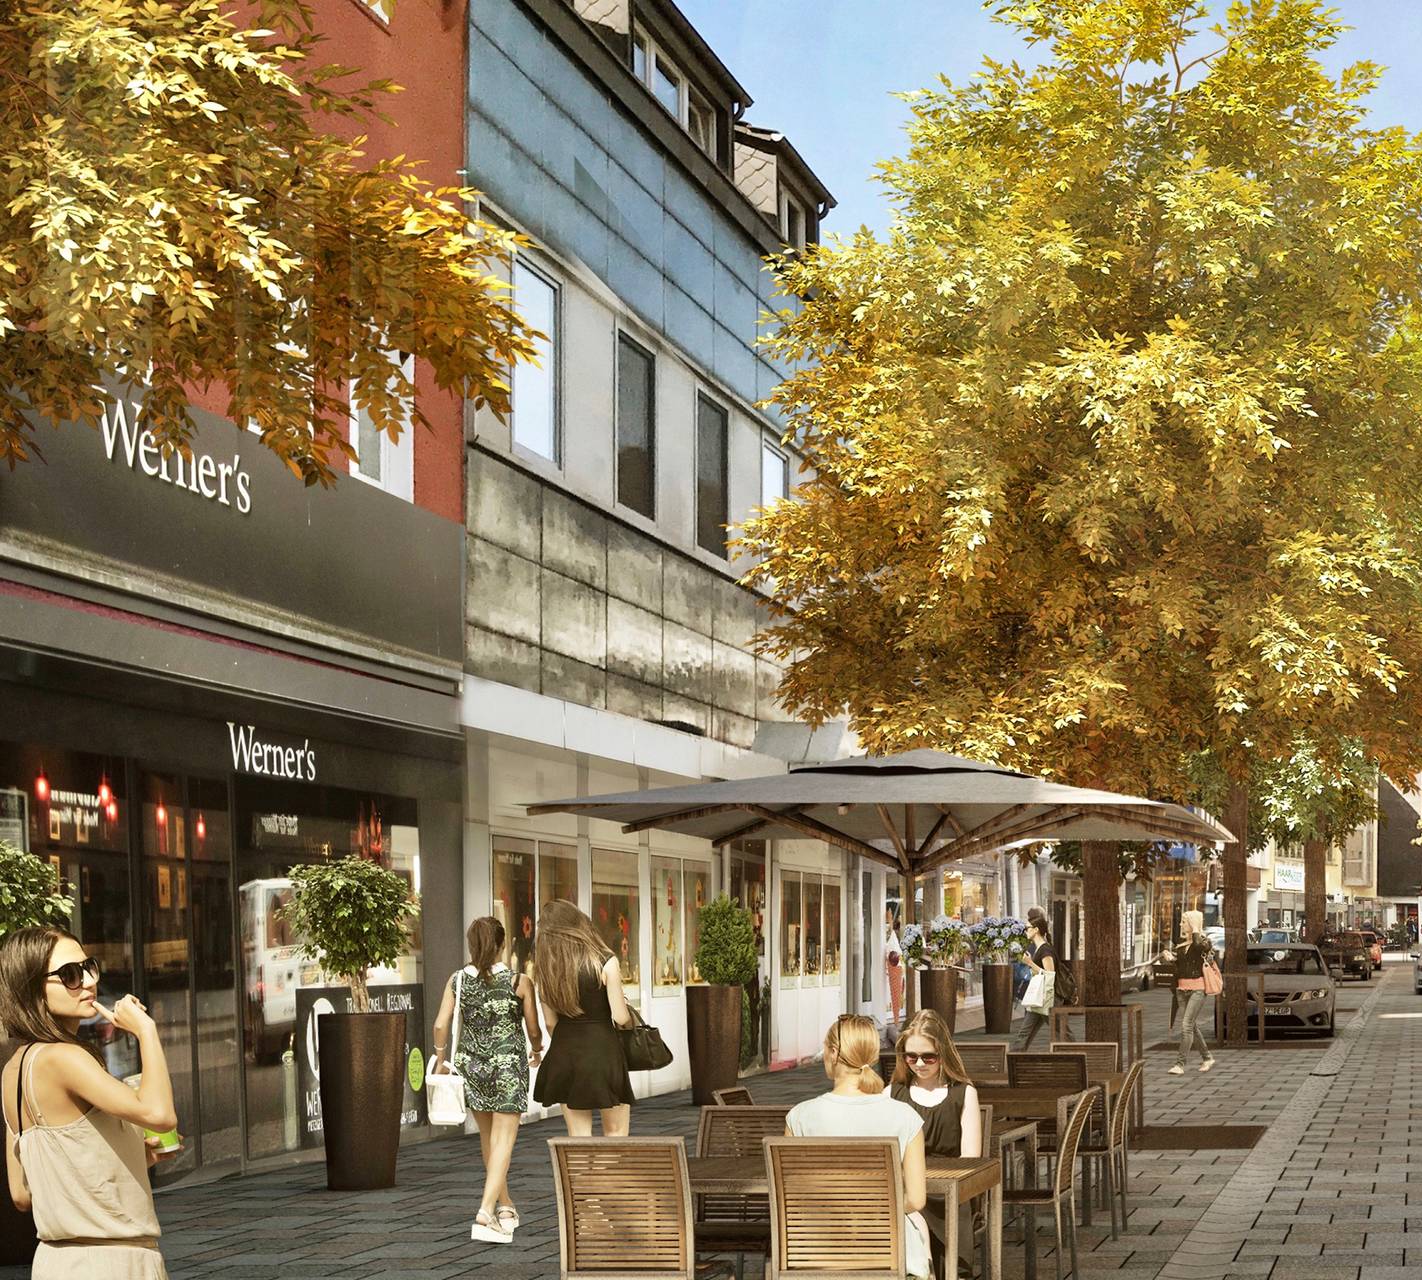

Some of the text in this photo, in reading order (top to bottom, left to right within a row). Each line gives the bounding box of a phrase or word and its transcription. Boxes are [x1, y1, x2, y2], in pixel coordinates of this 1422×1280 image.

[92, 385, 251, 514] Werner's
[226, 721, 316, 781] Werner's
[346, 995, 384, 1013] TRONELL
